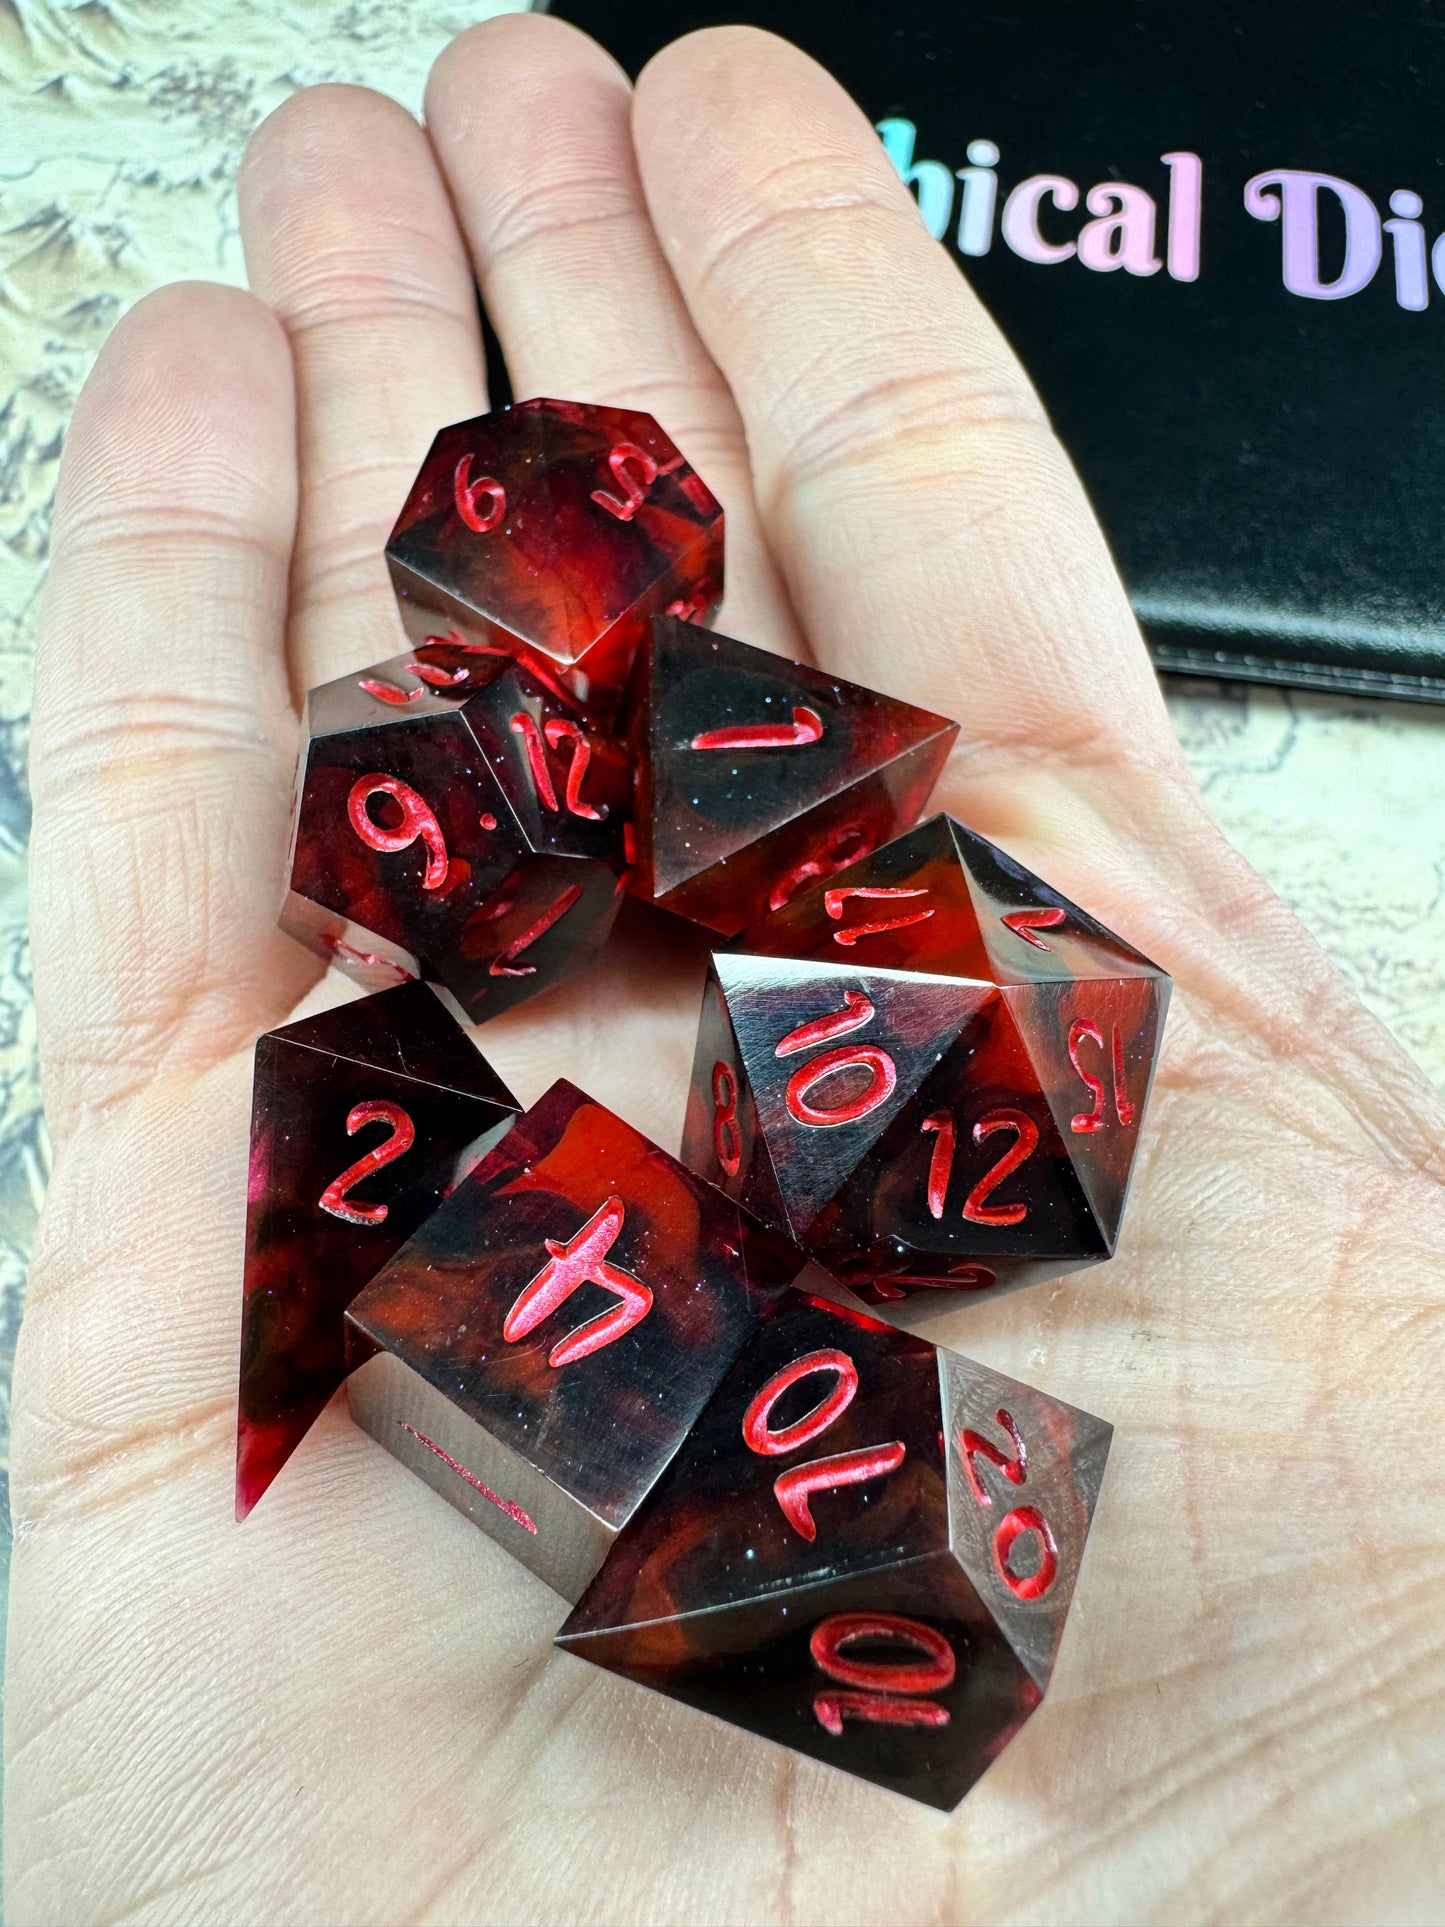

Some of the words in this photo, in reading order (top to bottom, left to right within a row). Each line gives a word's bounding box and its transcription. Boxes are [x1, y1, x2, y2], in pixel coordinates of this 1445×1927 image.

[1244, 169, 1445, 311] Di
[509, 712, 610, 821] 12
[712, 1060, 742, 1177] 8
[774, 990, 897, 1128] 10
[319, 1100, 415, 1226] 2
[920, 1108, 1039, 1227] 12
[503, 1194, 654, 1368] 4
[958, 1408, 1059, 1601] 20
[810, 1610, 957, 1736] 10
